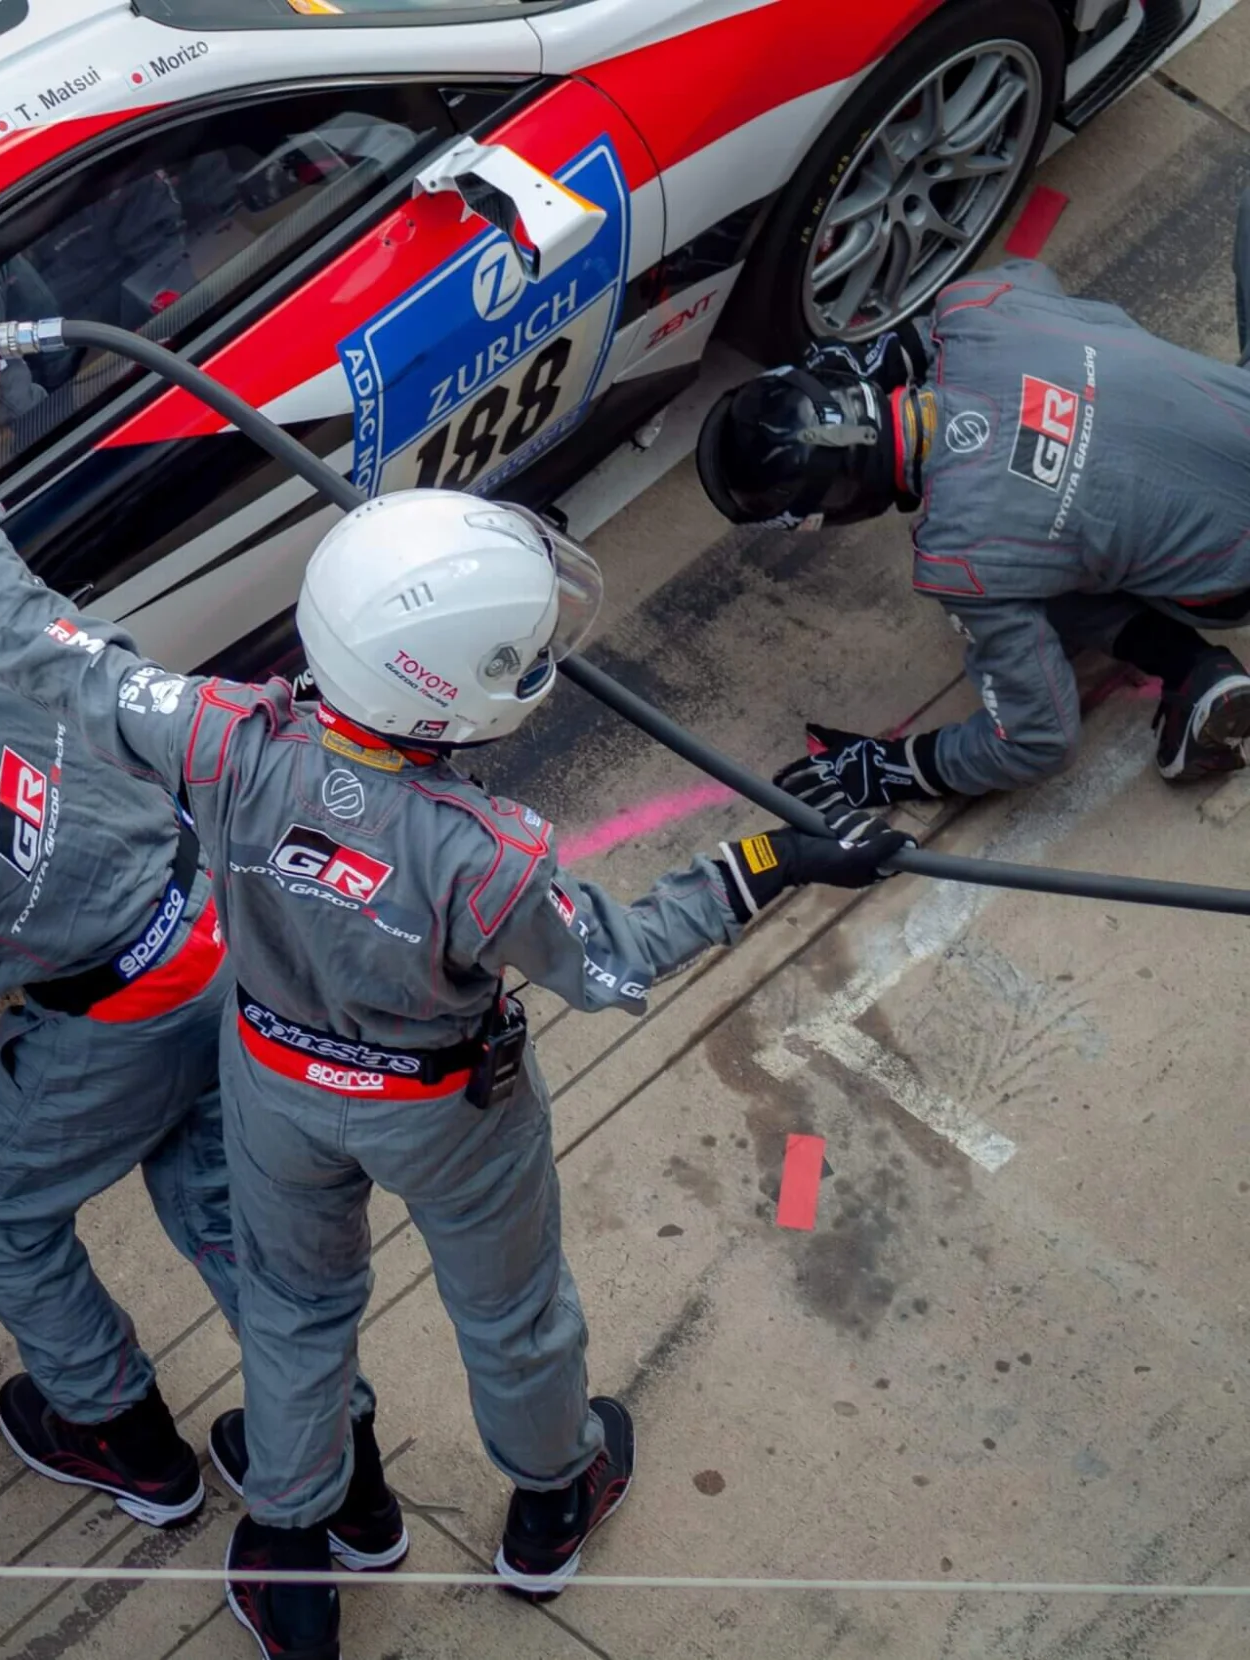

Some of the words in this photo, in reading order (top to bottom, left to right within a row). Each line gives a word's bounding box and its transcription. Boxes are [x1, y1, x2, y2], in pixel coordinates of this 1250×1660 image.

[148, 41, 209, 77] Morizo
[15, 104, 38, 122] T.
[37, 66, 102, 110] Matsui
[427, 279, 578, 422] ZURICH
[1084, 345, 1097, 402] Racing
[345, 349, 376, 442] ADAC
[415, 336, 573, 492] 188
[1033, 388, 1074, 484] GR
[1074, 404, 1095, 470] GAZOO
[1049, 473, 1081, 541] TOYOTA
[384, 662, 419, 689] GAZOO
[393, 650, 459, 700] TOYOTA
[50, 722, 66, 785] Racing
[13, 766, 43, 872] GR
[44, 788, 60, 857] GAZOO
[11, 861, 49, 934] TOYOTA
[274, 844, 374, 899] GR
[119, 888, 185, 978] sparco
[288, 883, 359, 911] GAZOO
[361, 907, 422, 944] Racing
[306, 1063, 384, 1090] sparco
